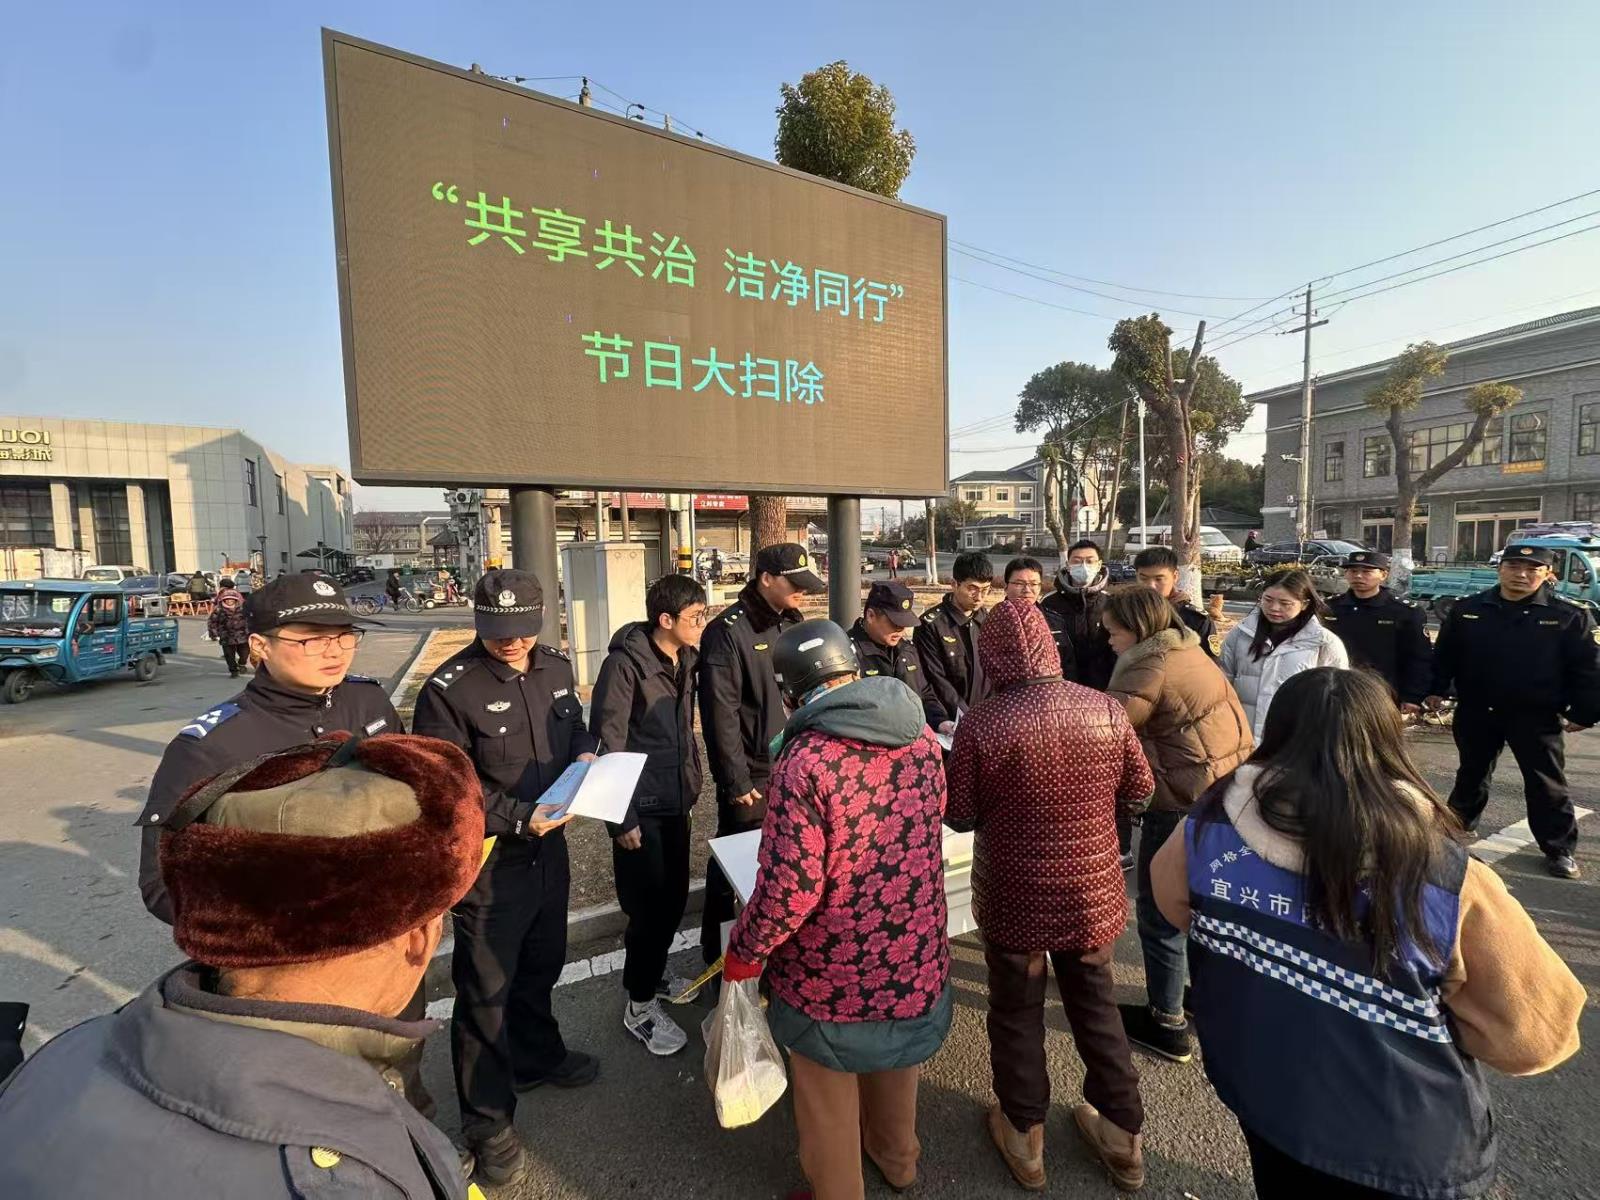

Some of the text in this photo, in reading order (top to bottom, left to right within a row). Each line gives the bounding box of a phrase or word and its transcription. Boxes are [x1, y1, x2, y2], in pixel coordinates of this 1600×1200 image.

[432, 181, 904, 323] “共享共治 洁净同行”
[581, 330, 825, 406] 节日大扫除
